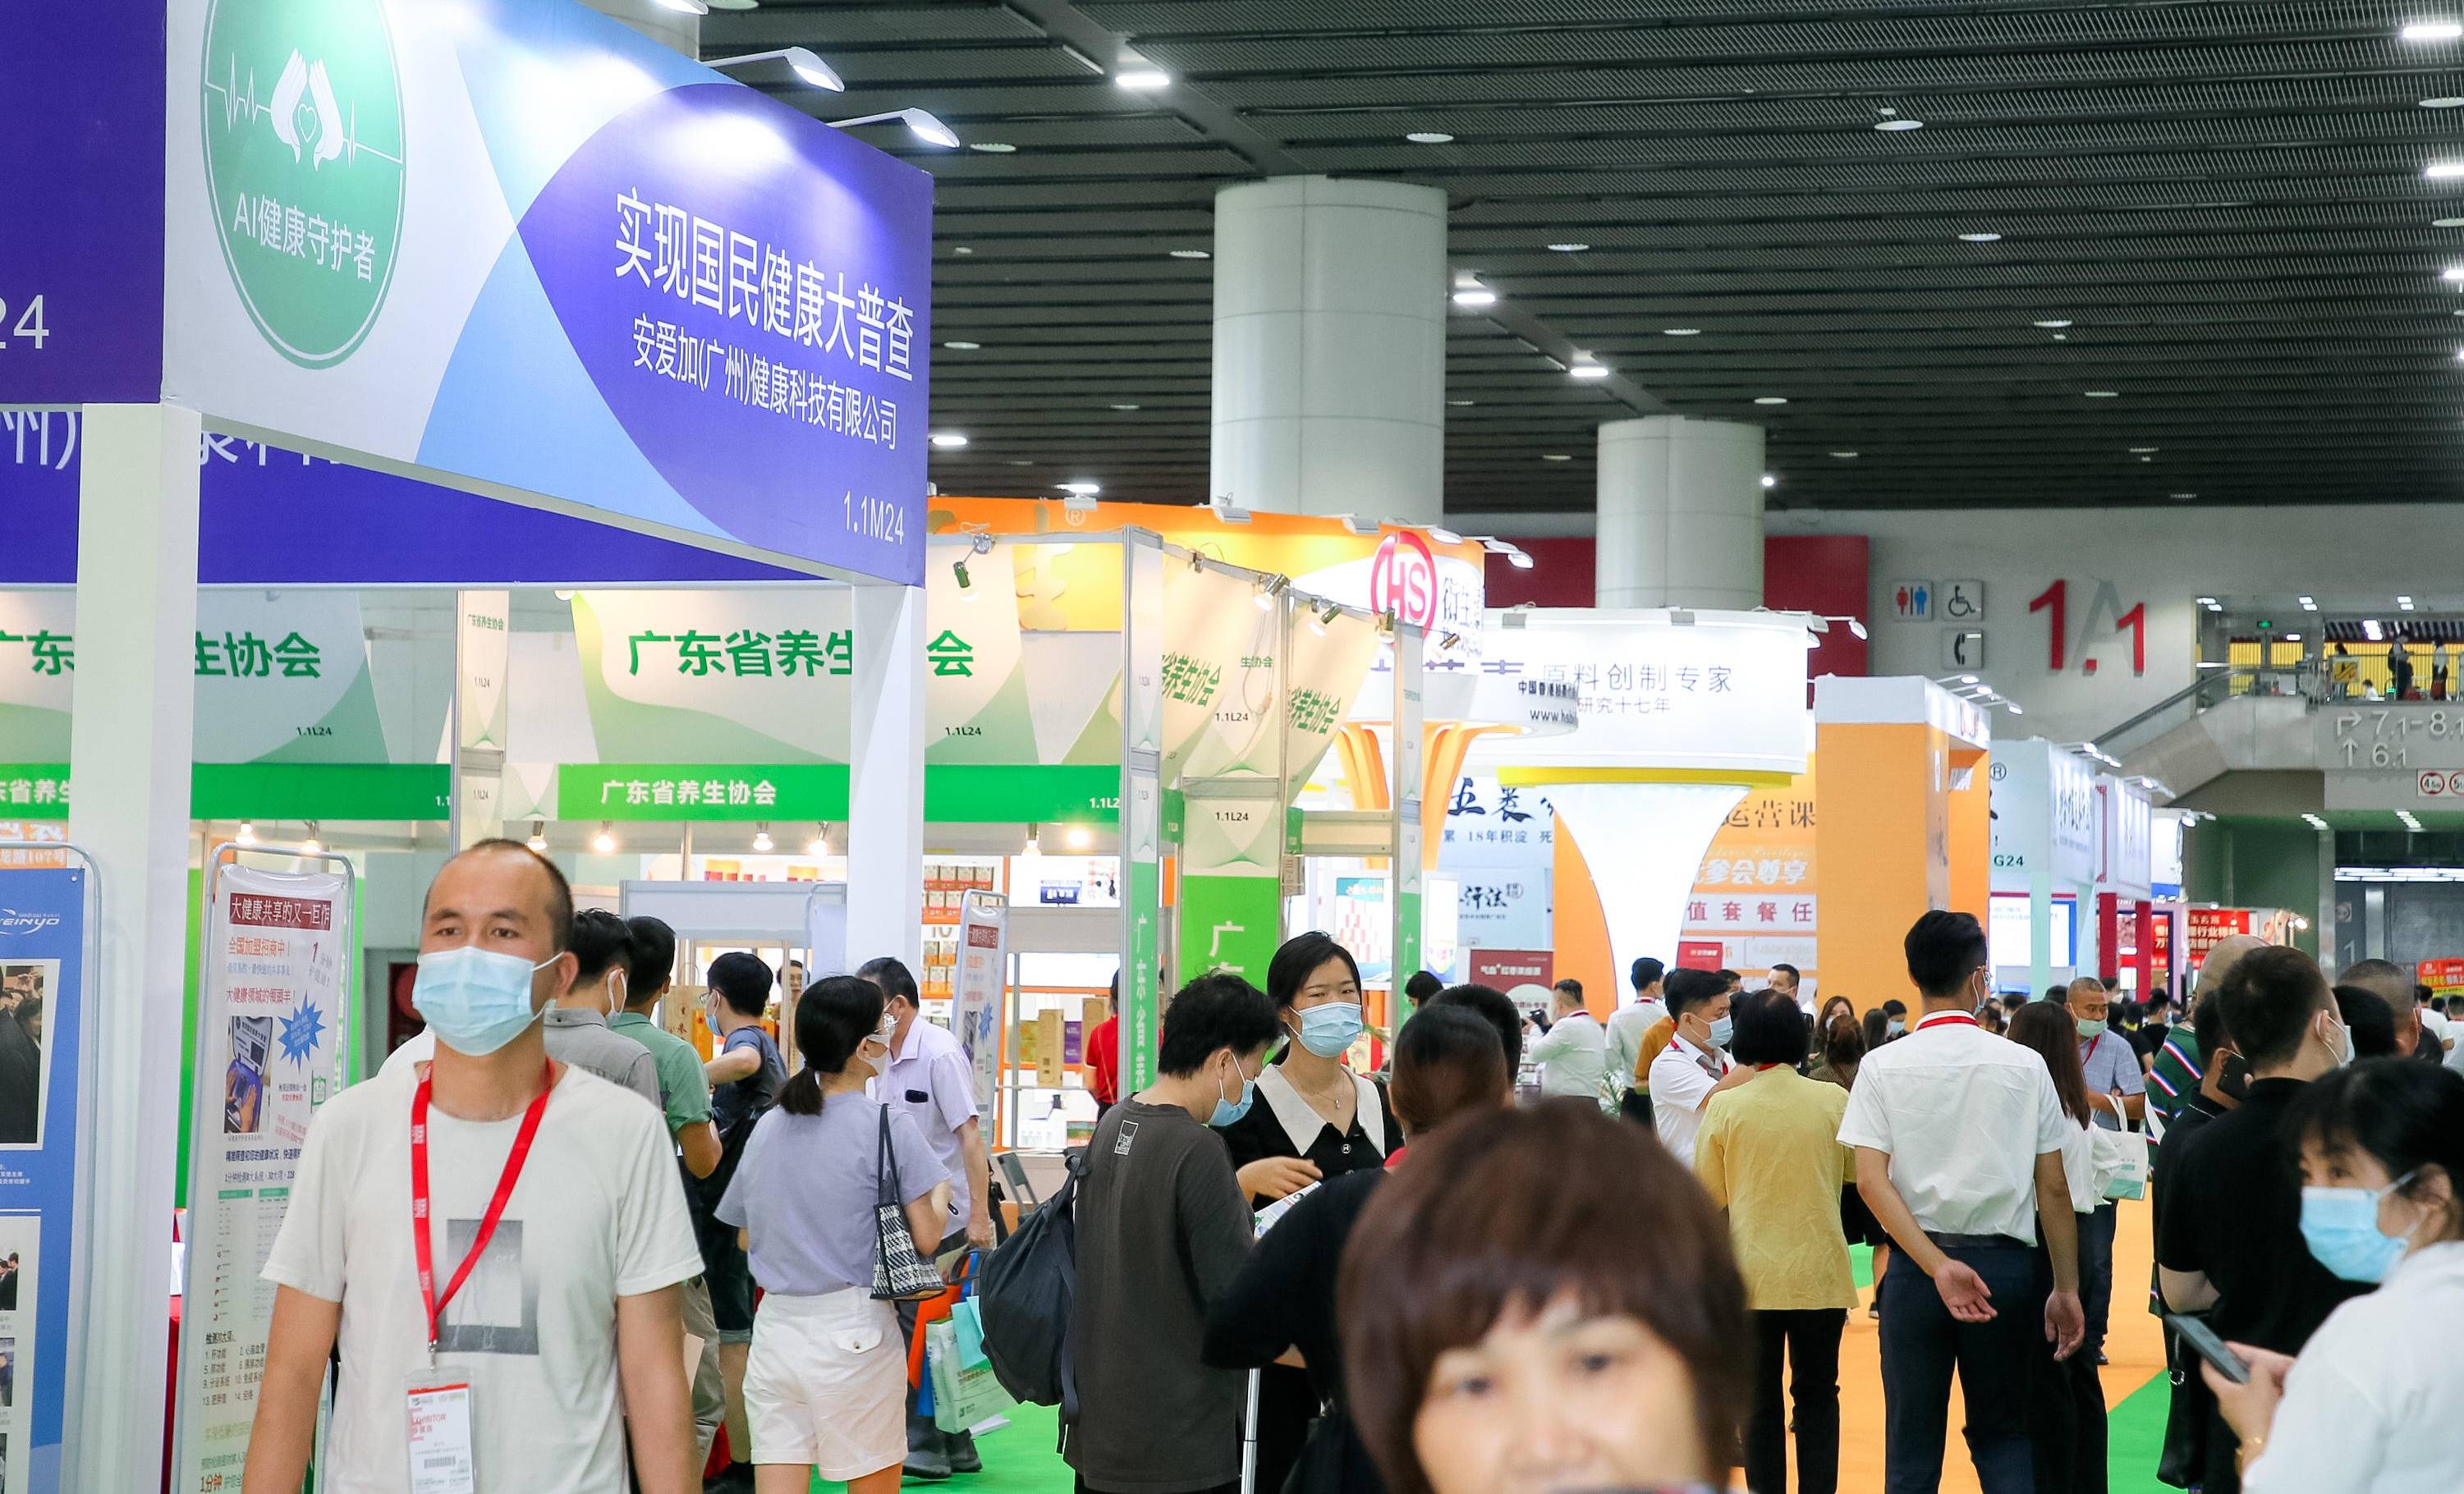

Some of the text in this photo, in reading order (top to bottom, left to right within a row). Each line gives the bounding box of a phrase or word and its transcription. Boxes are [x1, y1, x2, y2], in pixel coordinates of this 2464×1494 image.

[233, 192, 376, 283] AI健康守护者
[614, 186, 914, 382] 实现国民健康大普查
[0, 294, 50, 350] 4
[844, 490, 904, 545] 1.1M24
[926, 630, 974, 677] 会
[945, 726, 982, 736] 1.1L24
[1215, 713, 1249, 722] 1.1L24
[296, 726, 332, 737] 1.1L24
[2372, 742, 2407, 768] 6.1
[601, 780, 777, 805] 广东省养生协会
[1215, 813, 1249, 822] 1.1L24
[1994, 855, 2024, 867] G24
[231, 897, 329, 925] 大健康共享的又一巨作
[1209, 920, 1245, 974] 广
